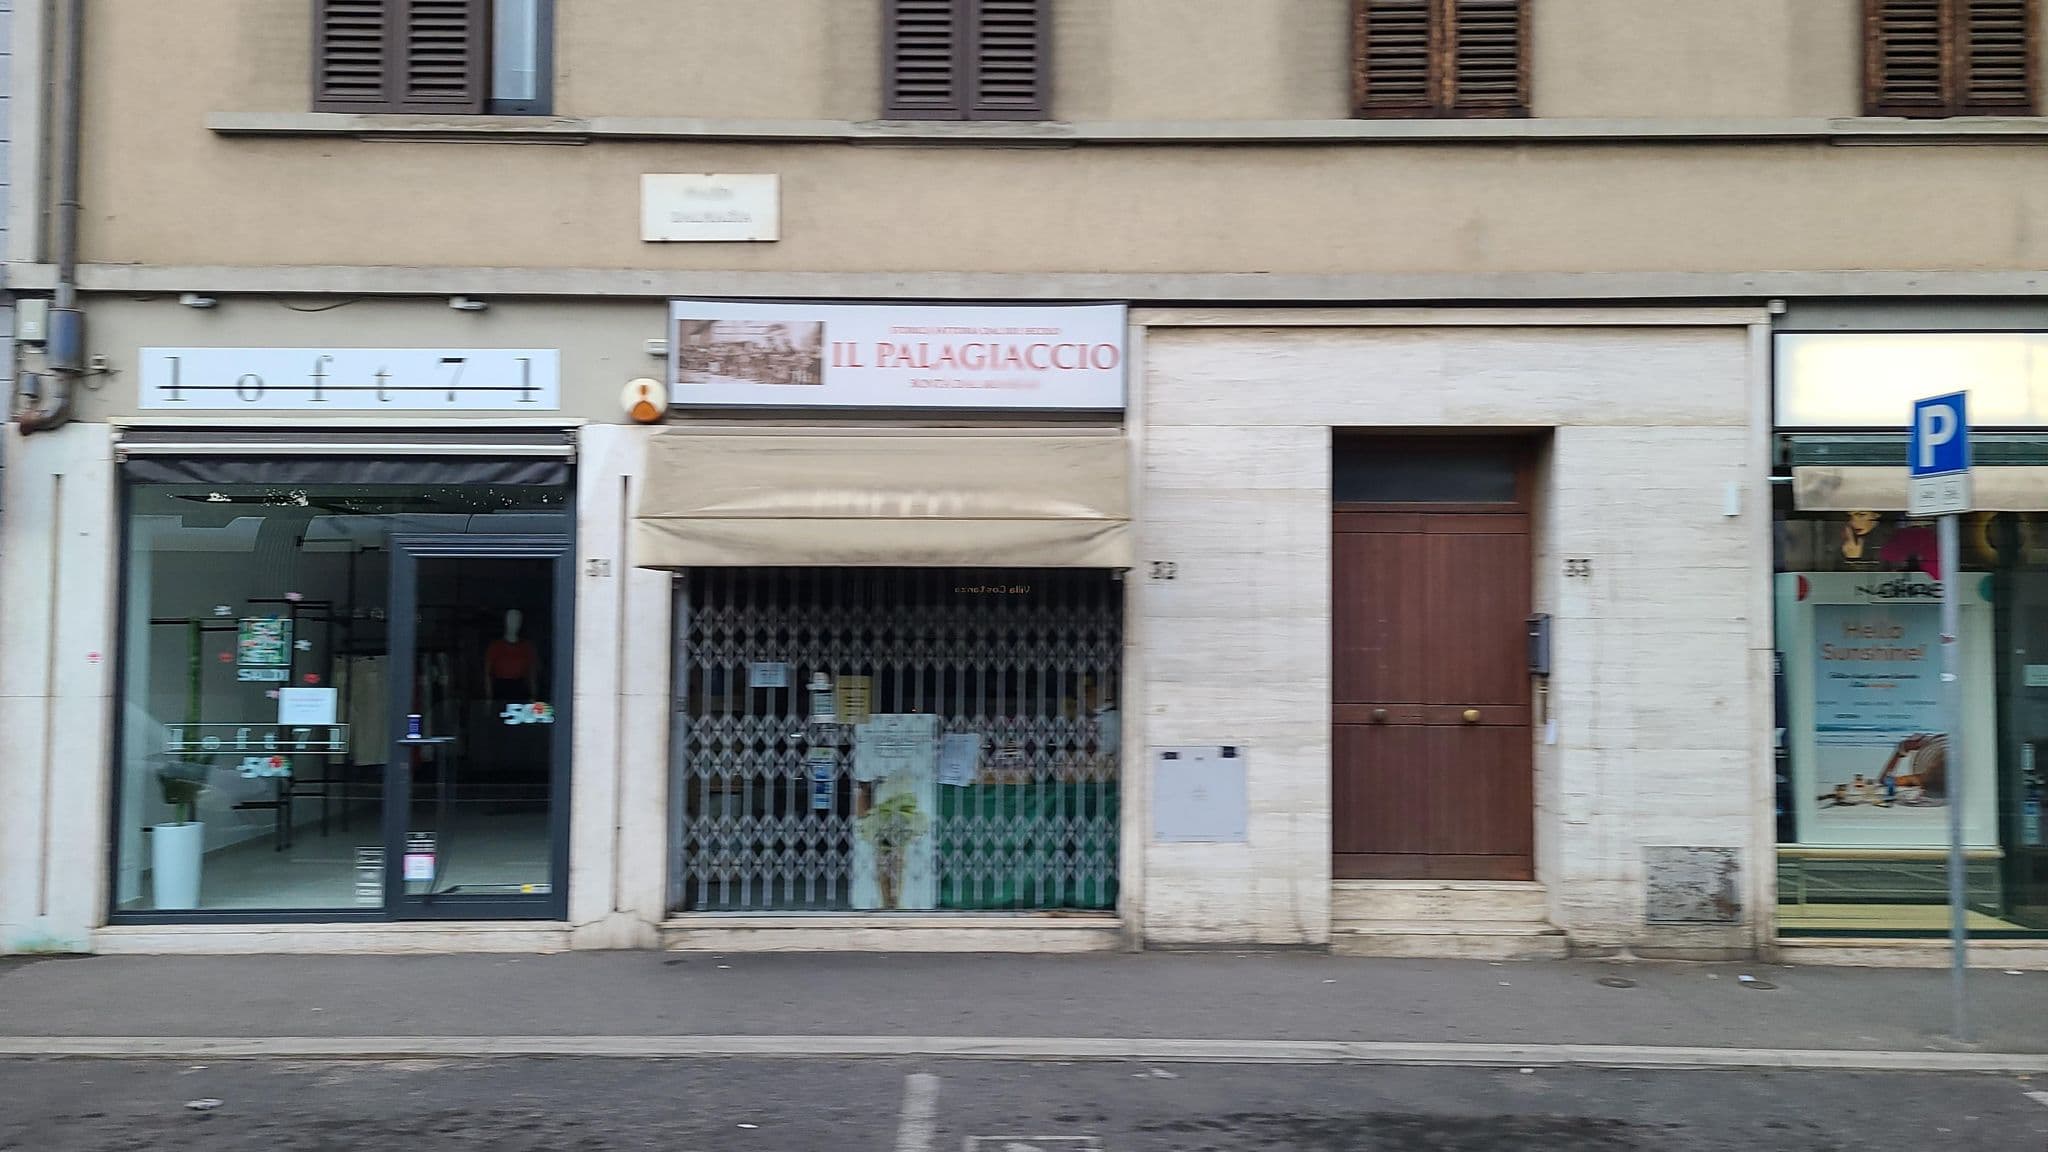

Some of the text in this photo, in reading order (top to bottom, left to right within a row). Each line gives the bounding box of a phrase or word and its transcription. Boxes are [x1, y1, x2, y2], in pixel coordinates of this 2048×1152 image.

[832, 341, 1121, 371] IL PALAGIACCIO
[1918, 404, 1959, 468] P
[1563, 558, 1593, 578] 33
